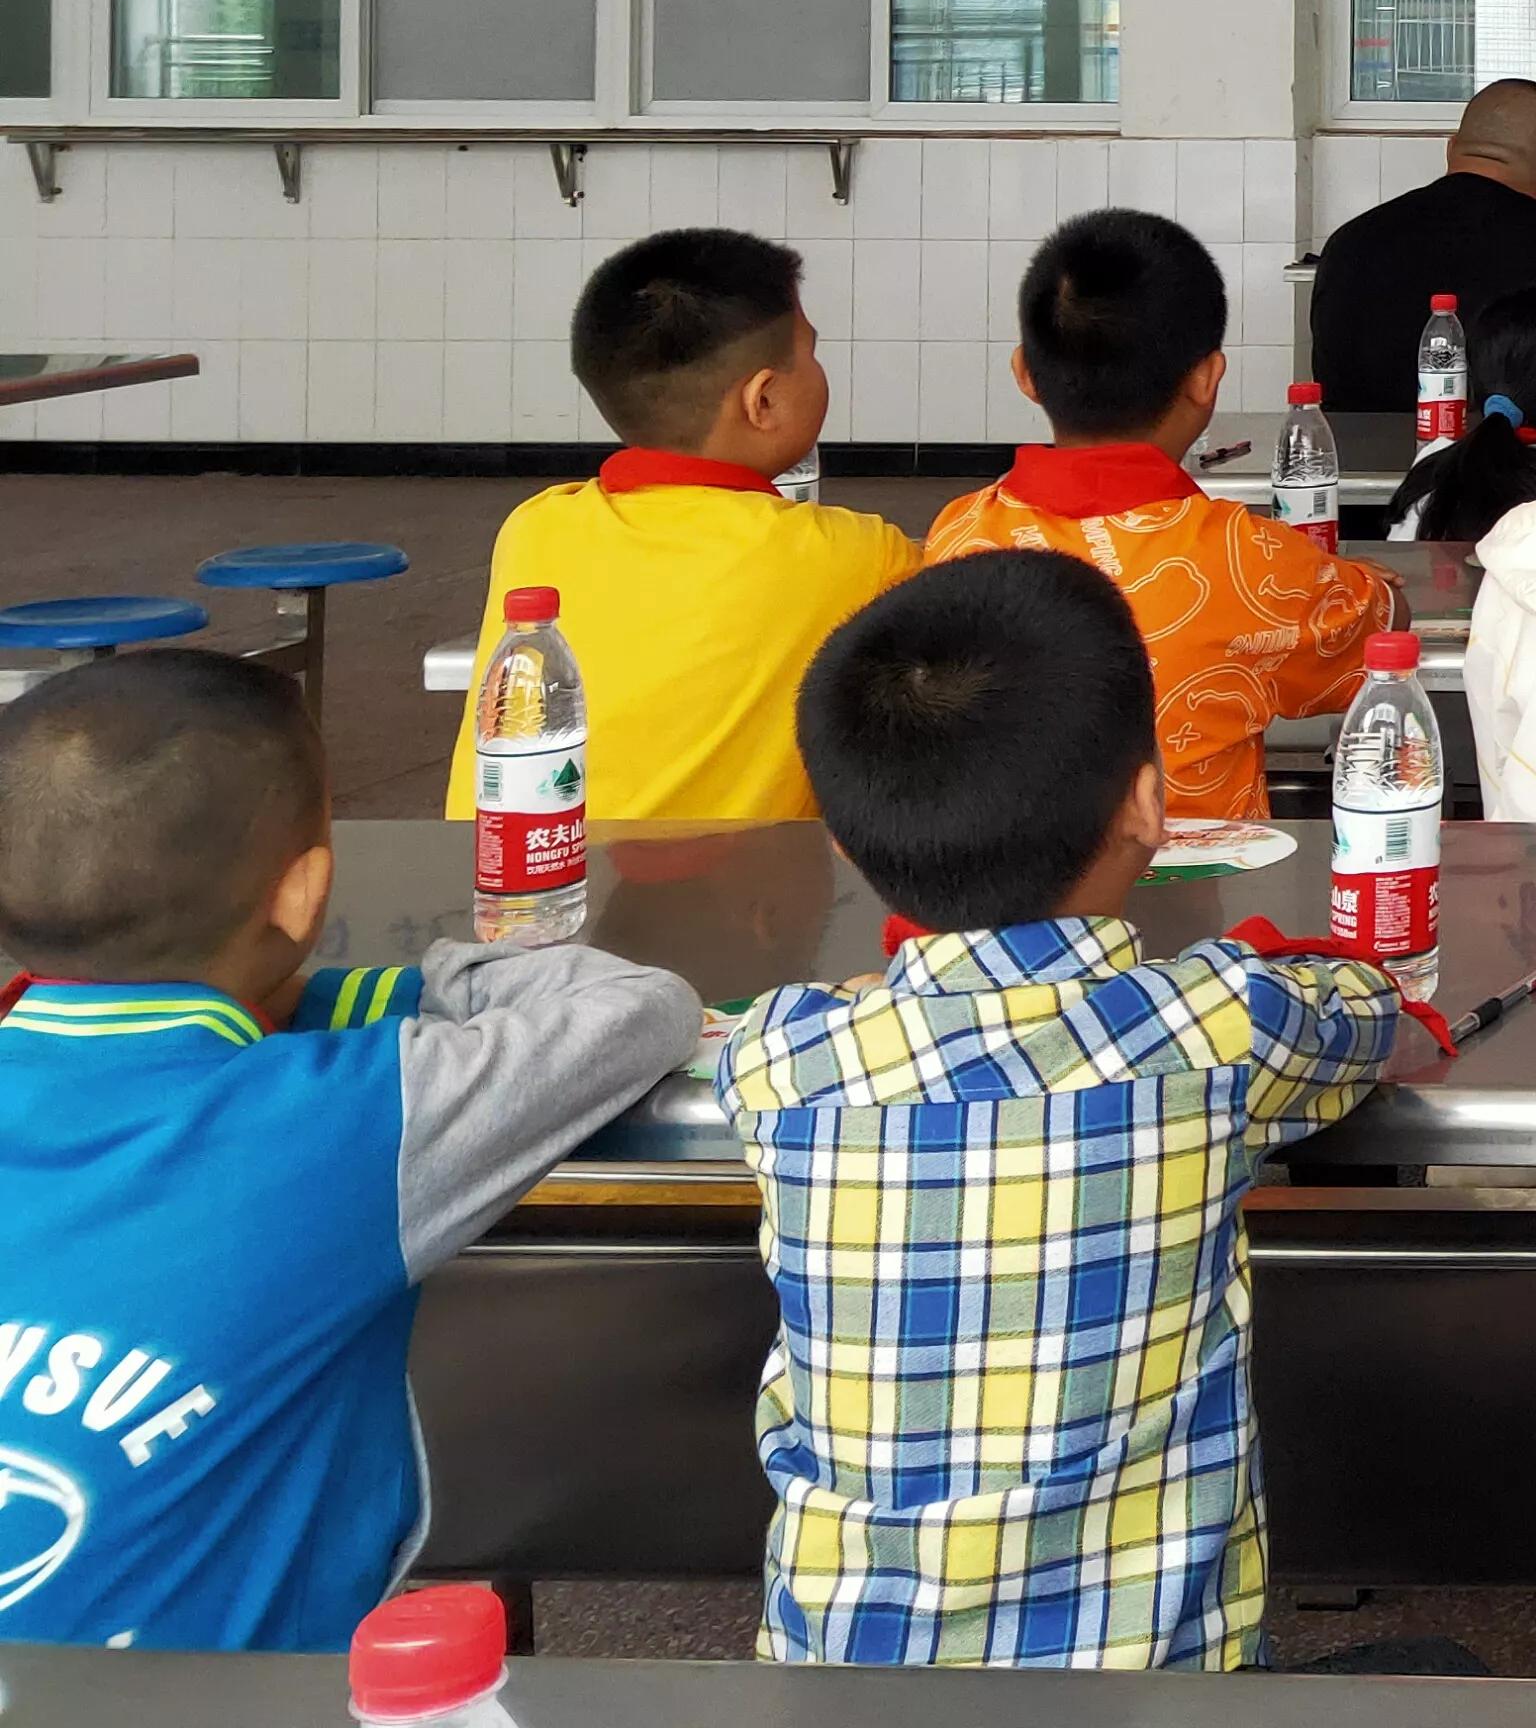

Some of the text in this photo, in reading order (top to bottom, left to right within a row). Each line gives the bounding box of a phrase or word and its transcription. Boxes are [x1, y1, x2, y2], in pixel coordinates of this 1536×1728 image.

[525, 819, 585, 850] 农夫山
[526, 845, 570, 864] NONGFU
